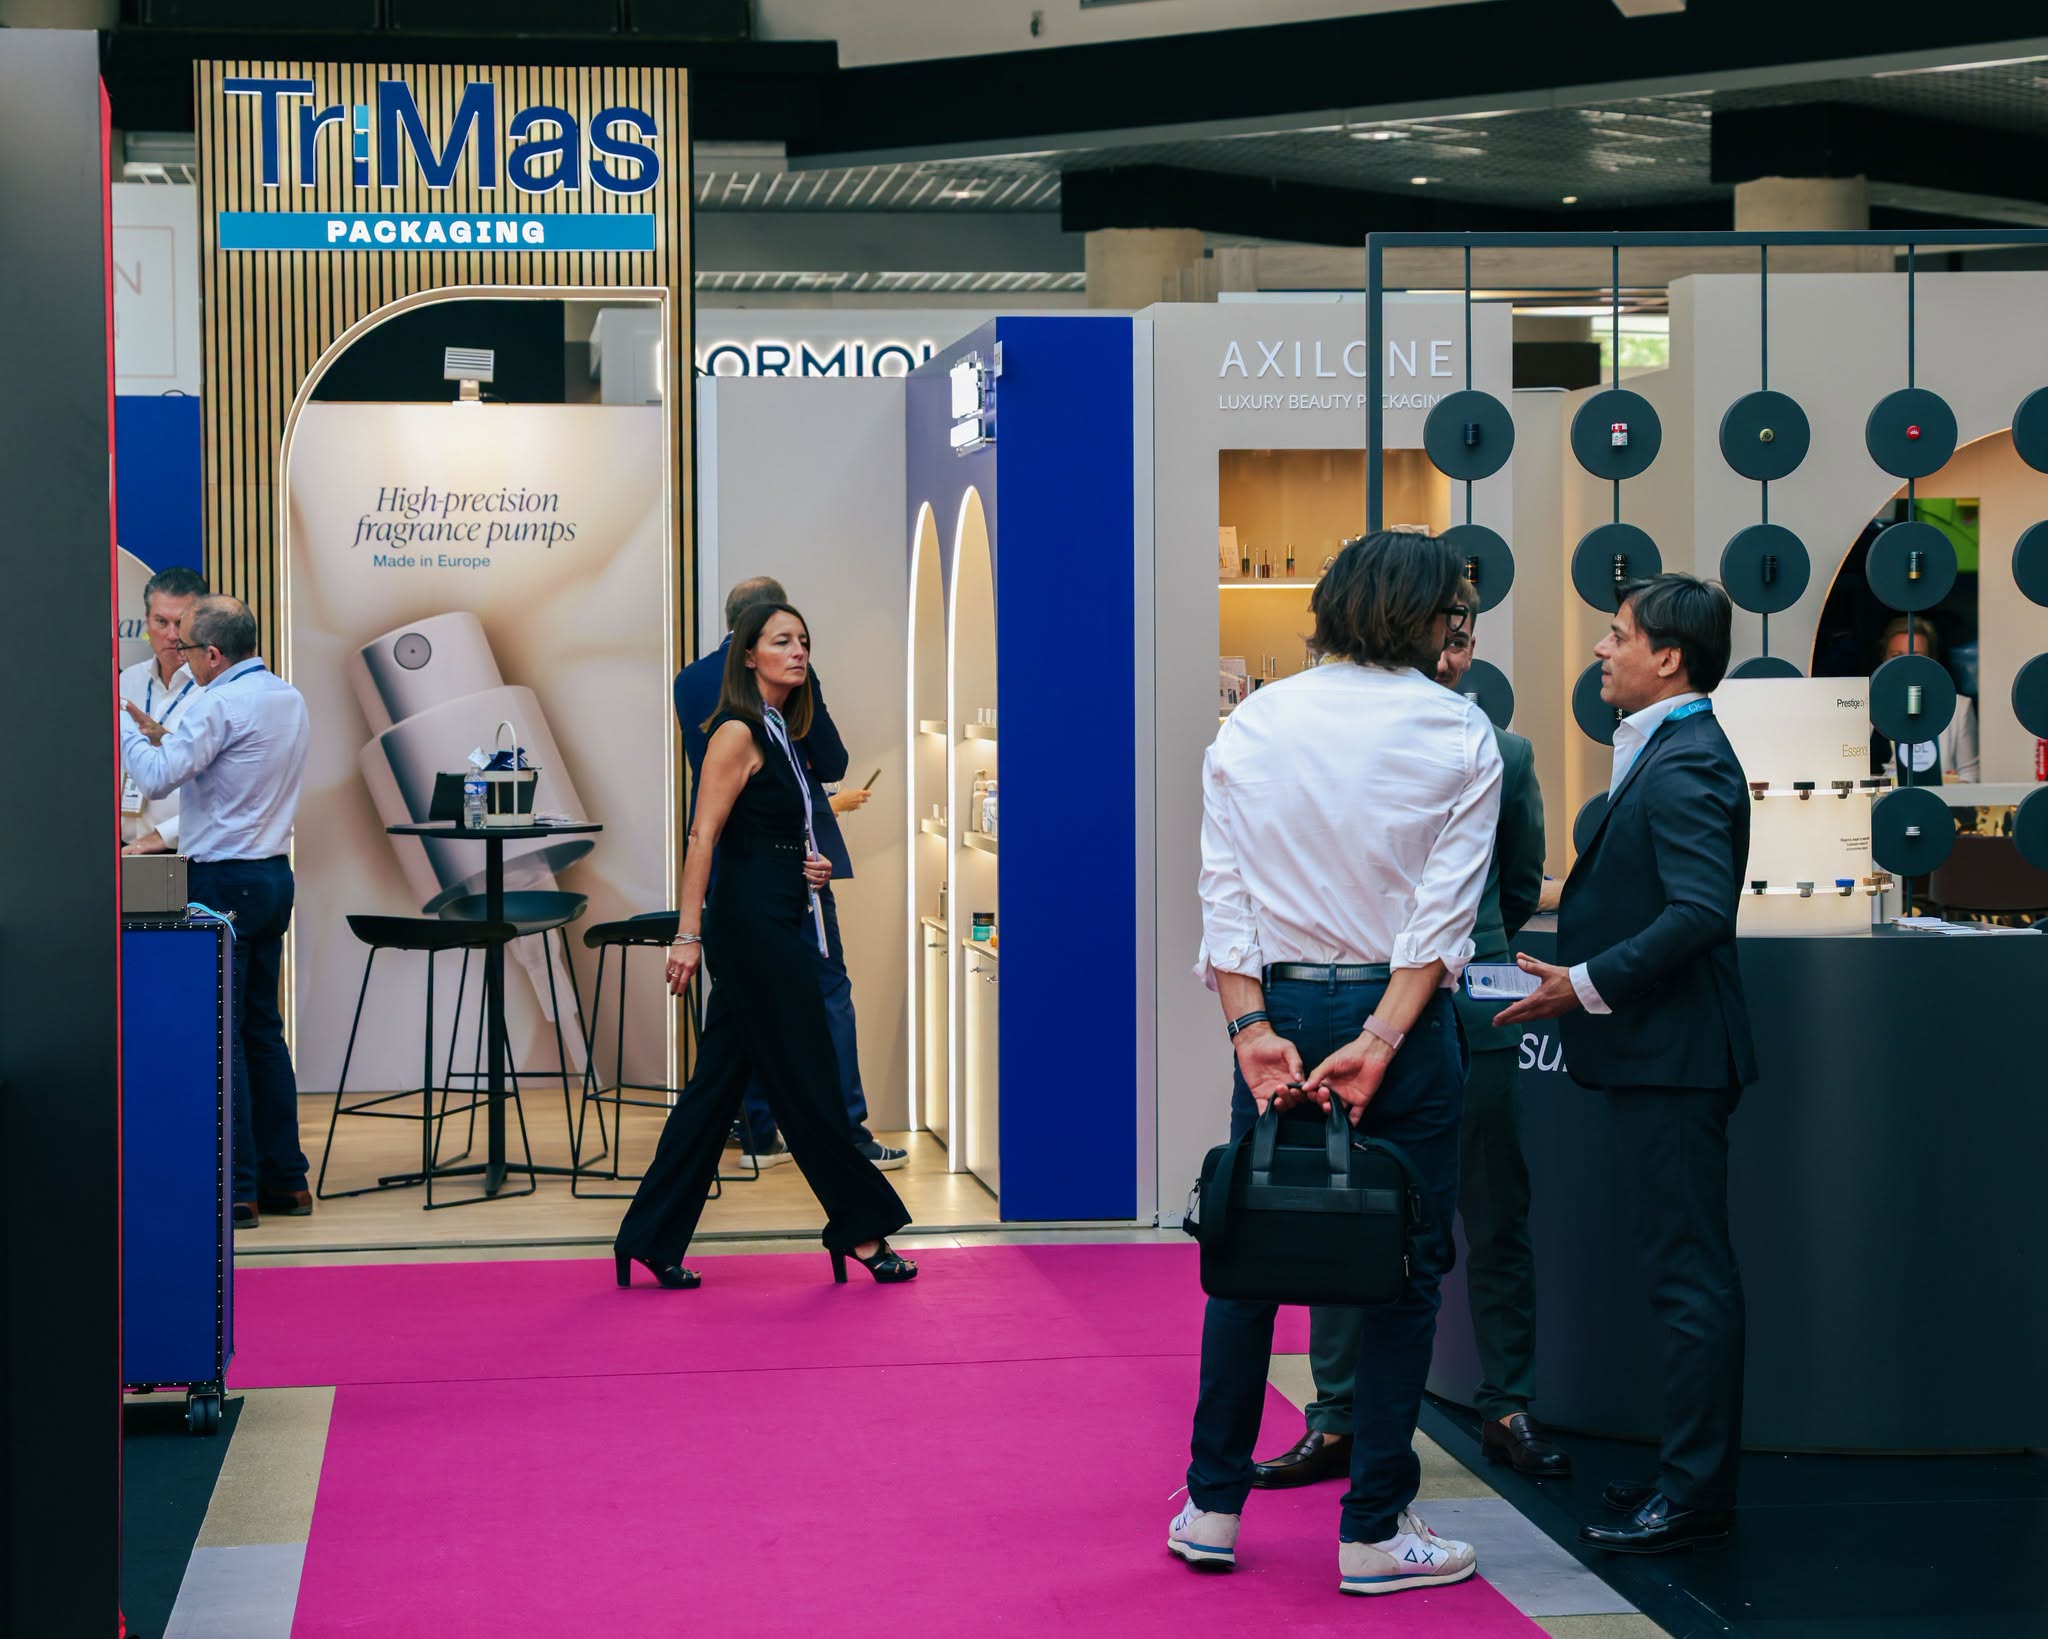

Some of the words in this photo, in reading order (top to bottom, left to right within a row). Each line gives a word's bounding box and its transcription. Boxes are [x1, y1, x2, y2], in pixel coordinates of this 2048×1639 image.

[224, 77, 660, 194] TriMas
[327, 220, 545, 244] PACKAGING
[1218, 340, 1453, 378] AXILONE
[1218, 394, 1286, 410] LUXURY
[1289, 394, 1352, 410] BEAUTY
[376, 486, 559, 519] High-precision
[352, 514, 481, 549] fragrance
[486, 521, 577, 549] pumps
[373, 555, 415, 568] Made
[420, 555, 433, 568] in
[438, 555, 491, 570] Europe
